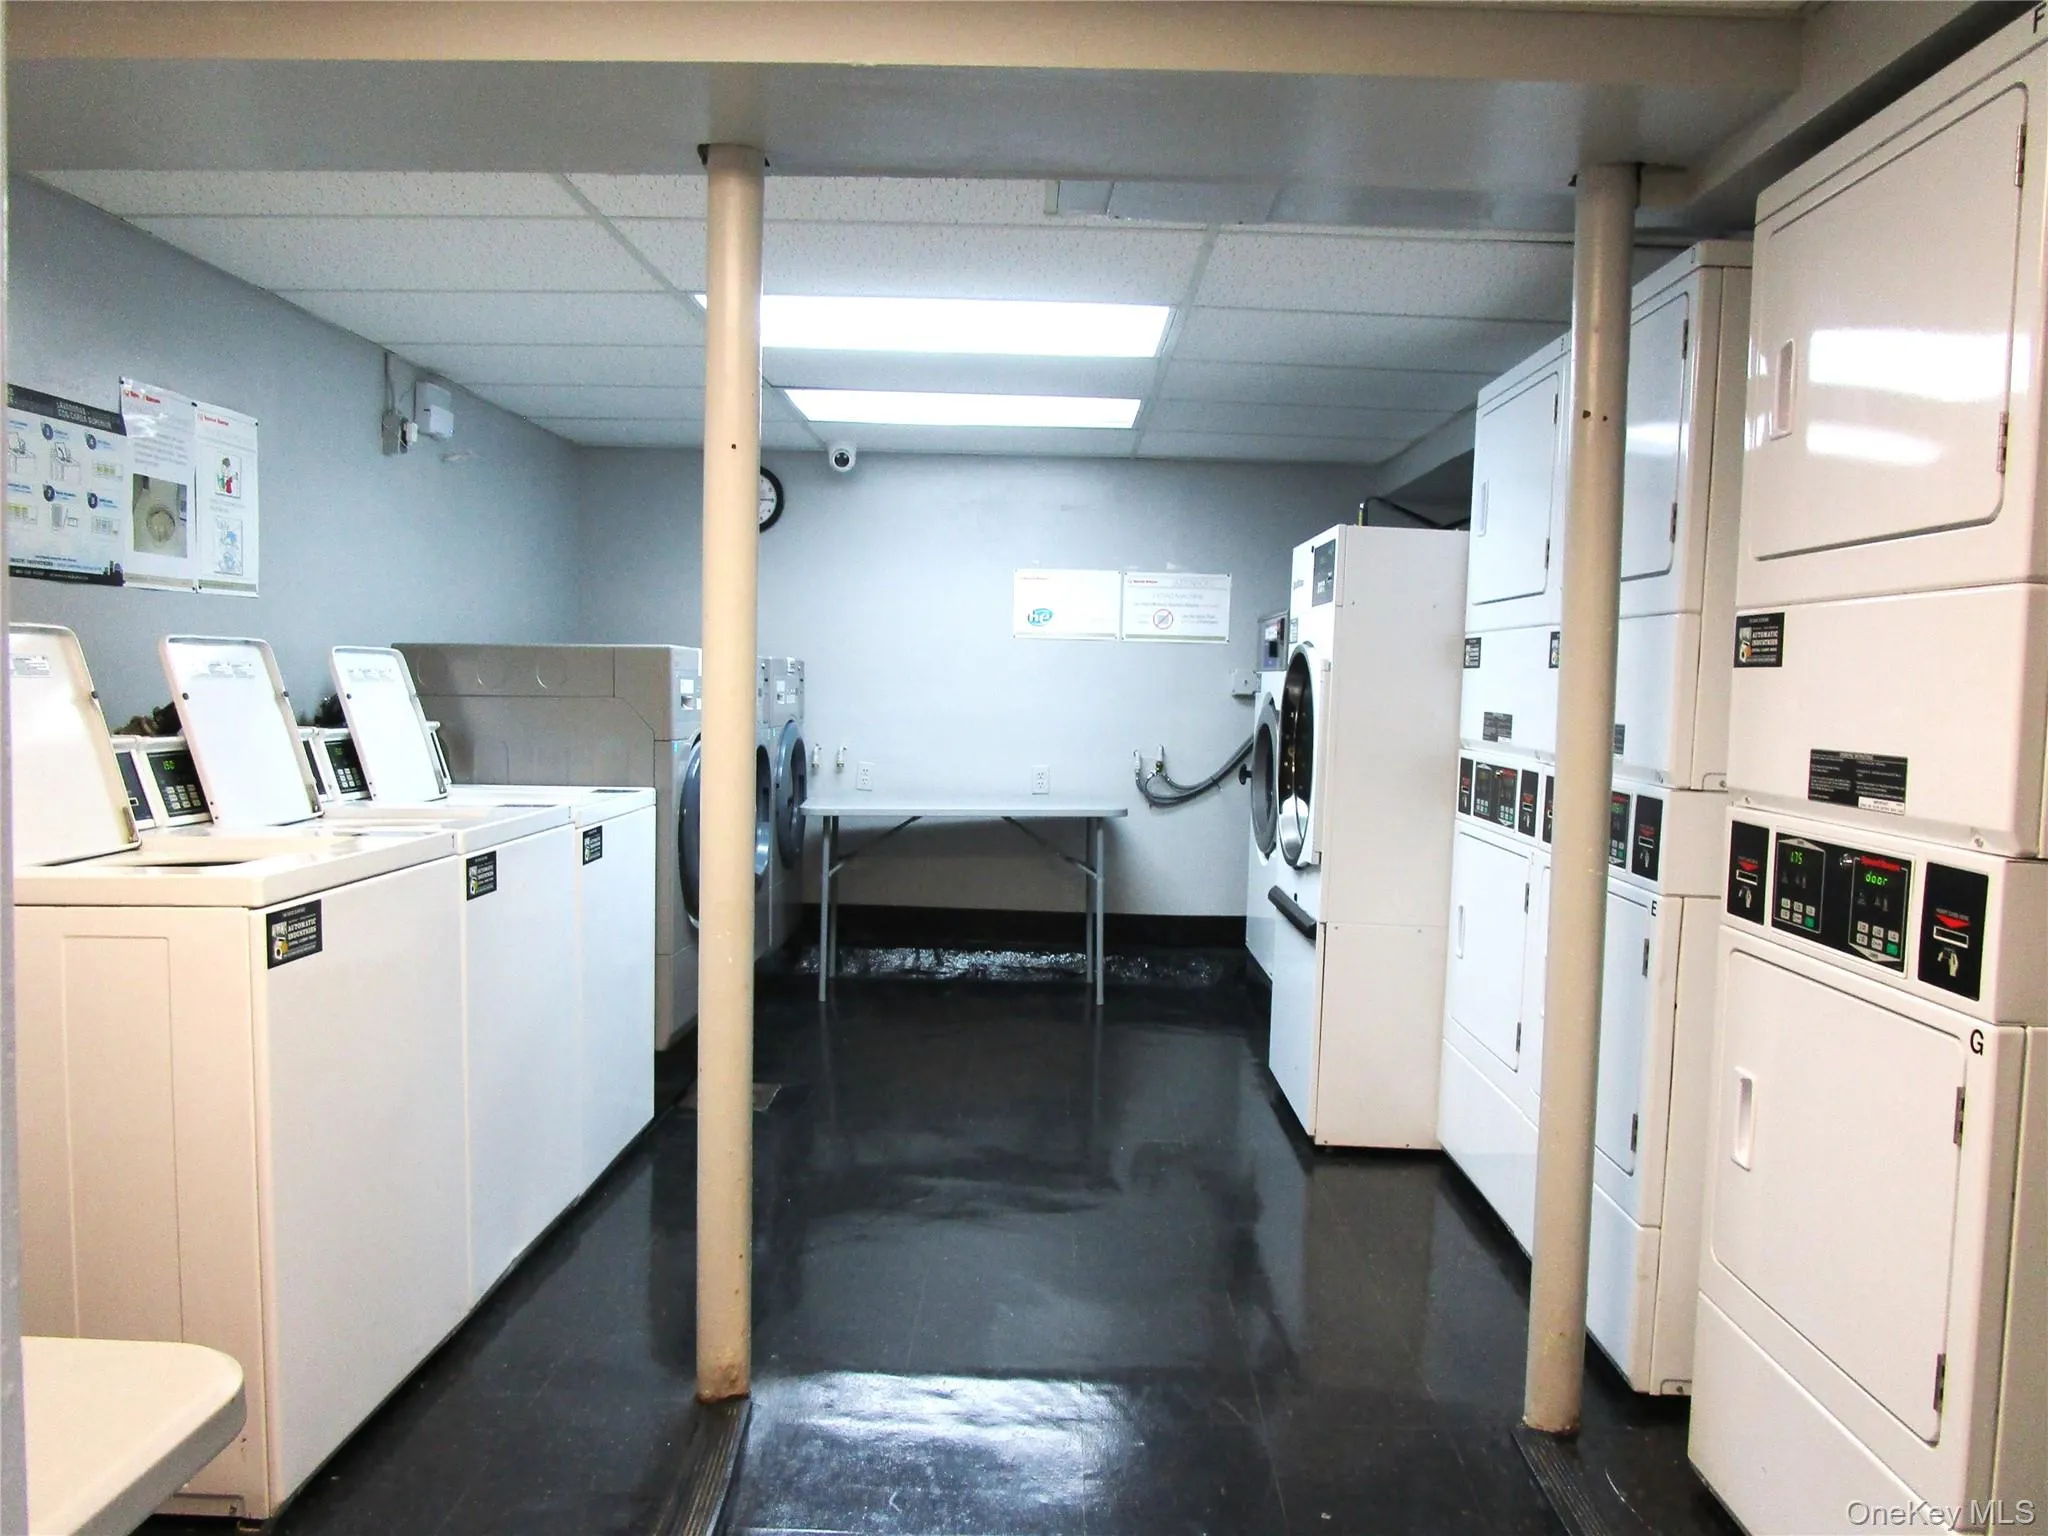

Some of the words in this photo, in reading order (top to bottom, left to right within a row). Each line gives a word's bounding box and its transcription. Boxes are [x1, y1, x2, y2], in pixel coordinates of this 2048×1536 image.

[2033, 2, 2047, 34] F
[1790, 851, 1803, 865] 175
[1865, 872, 1888, 886] door
[1651, 900, 1657, 917] E
[1970, 1029, 1984, 1056] G
